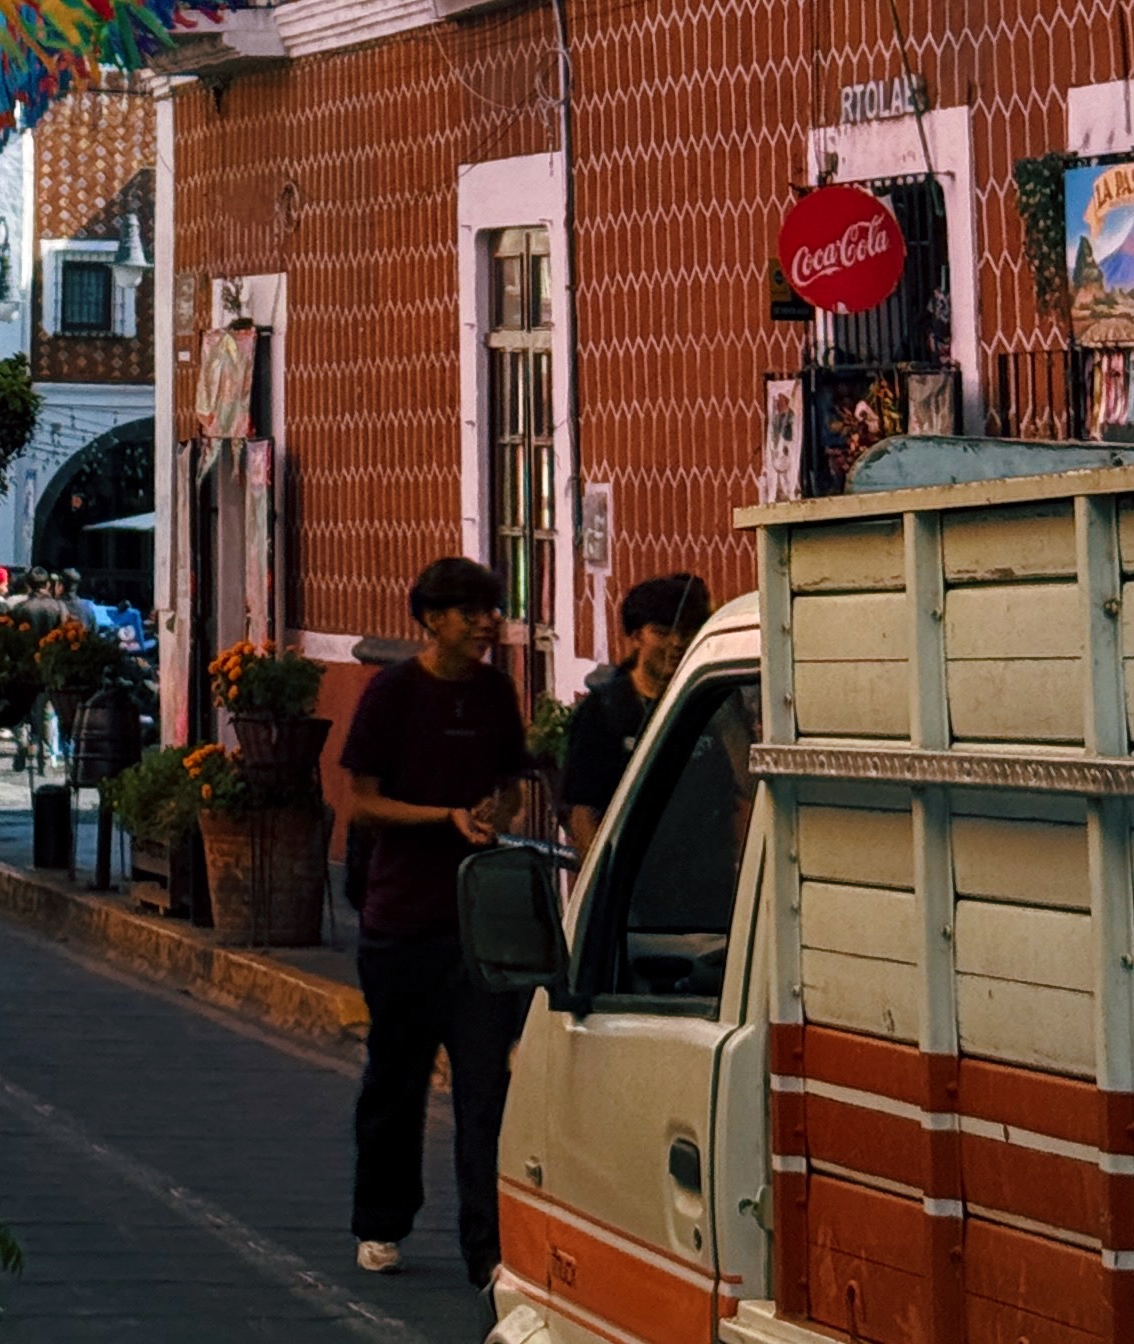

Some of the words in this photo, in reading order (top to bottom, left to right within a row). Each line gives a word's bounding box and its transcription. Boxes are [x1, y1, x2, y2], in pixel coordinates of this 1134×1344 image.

[1095, 176, 1114, 209] LA
[1114, 169, 1134, 198] PA
[792, 213, 887, 286] Coca-Cola
